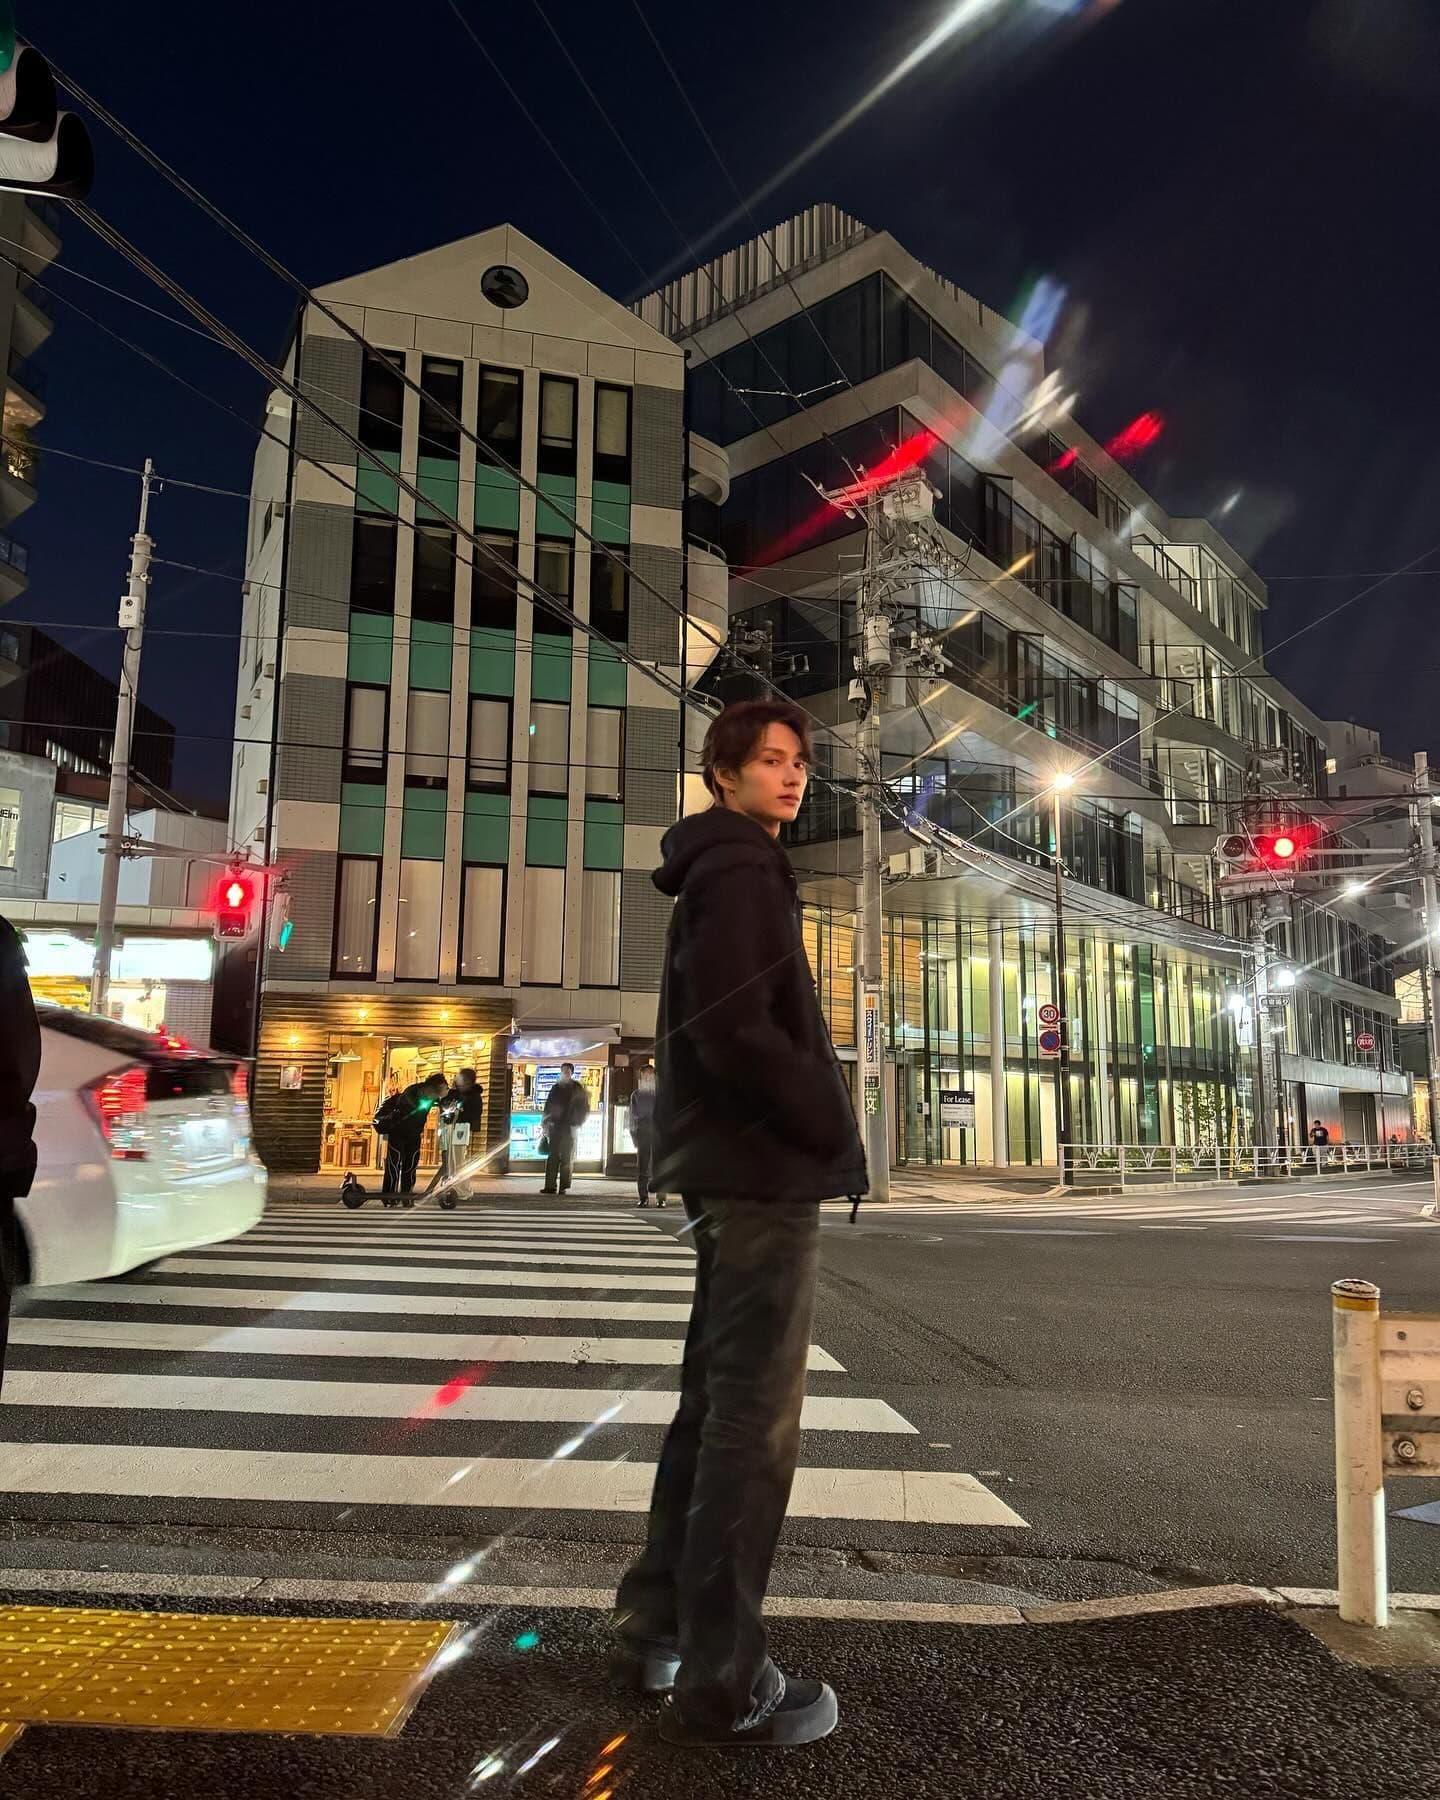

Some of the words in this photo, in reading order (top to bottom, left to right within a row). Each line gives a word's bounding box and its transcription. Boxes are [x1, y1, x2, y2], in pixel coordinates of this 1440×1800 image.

[1043, 1009, 1054, 1018] 30
[943, 1095, 954, 1103] For
[954, 1095, 971, 1103] Lease
